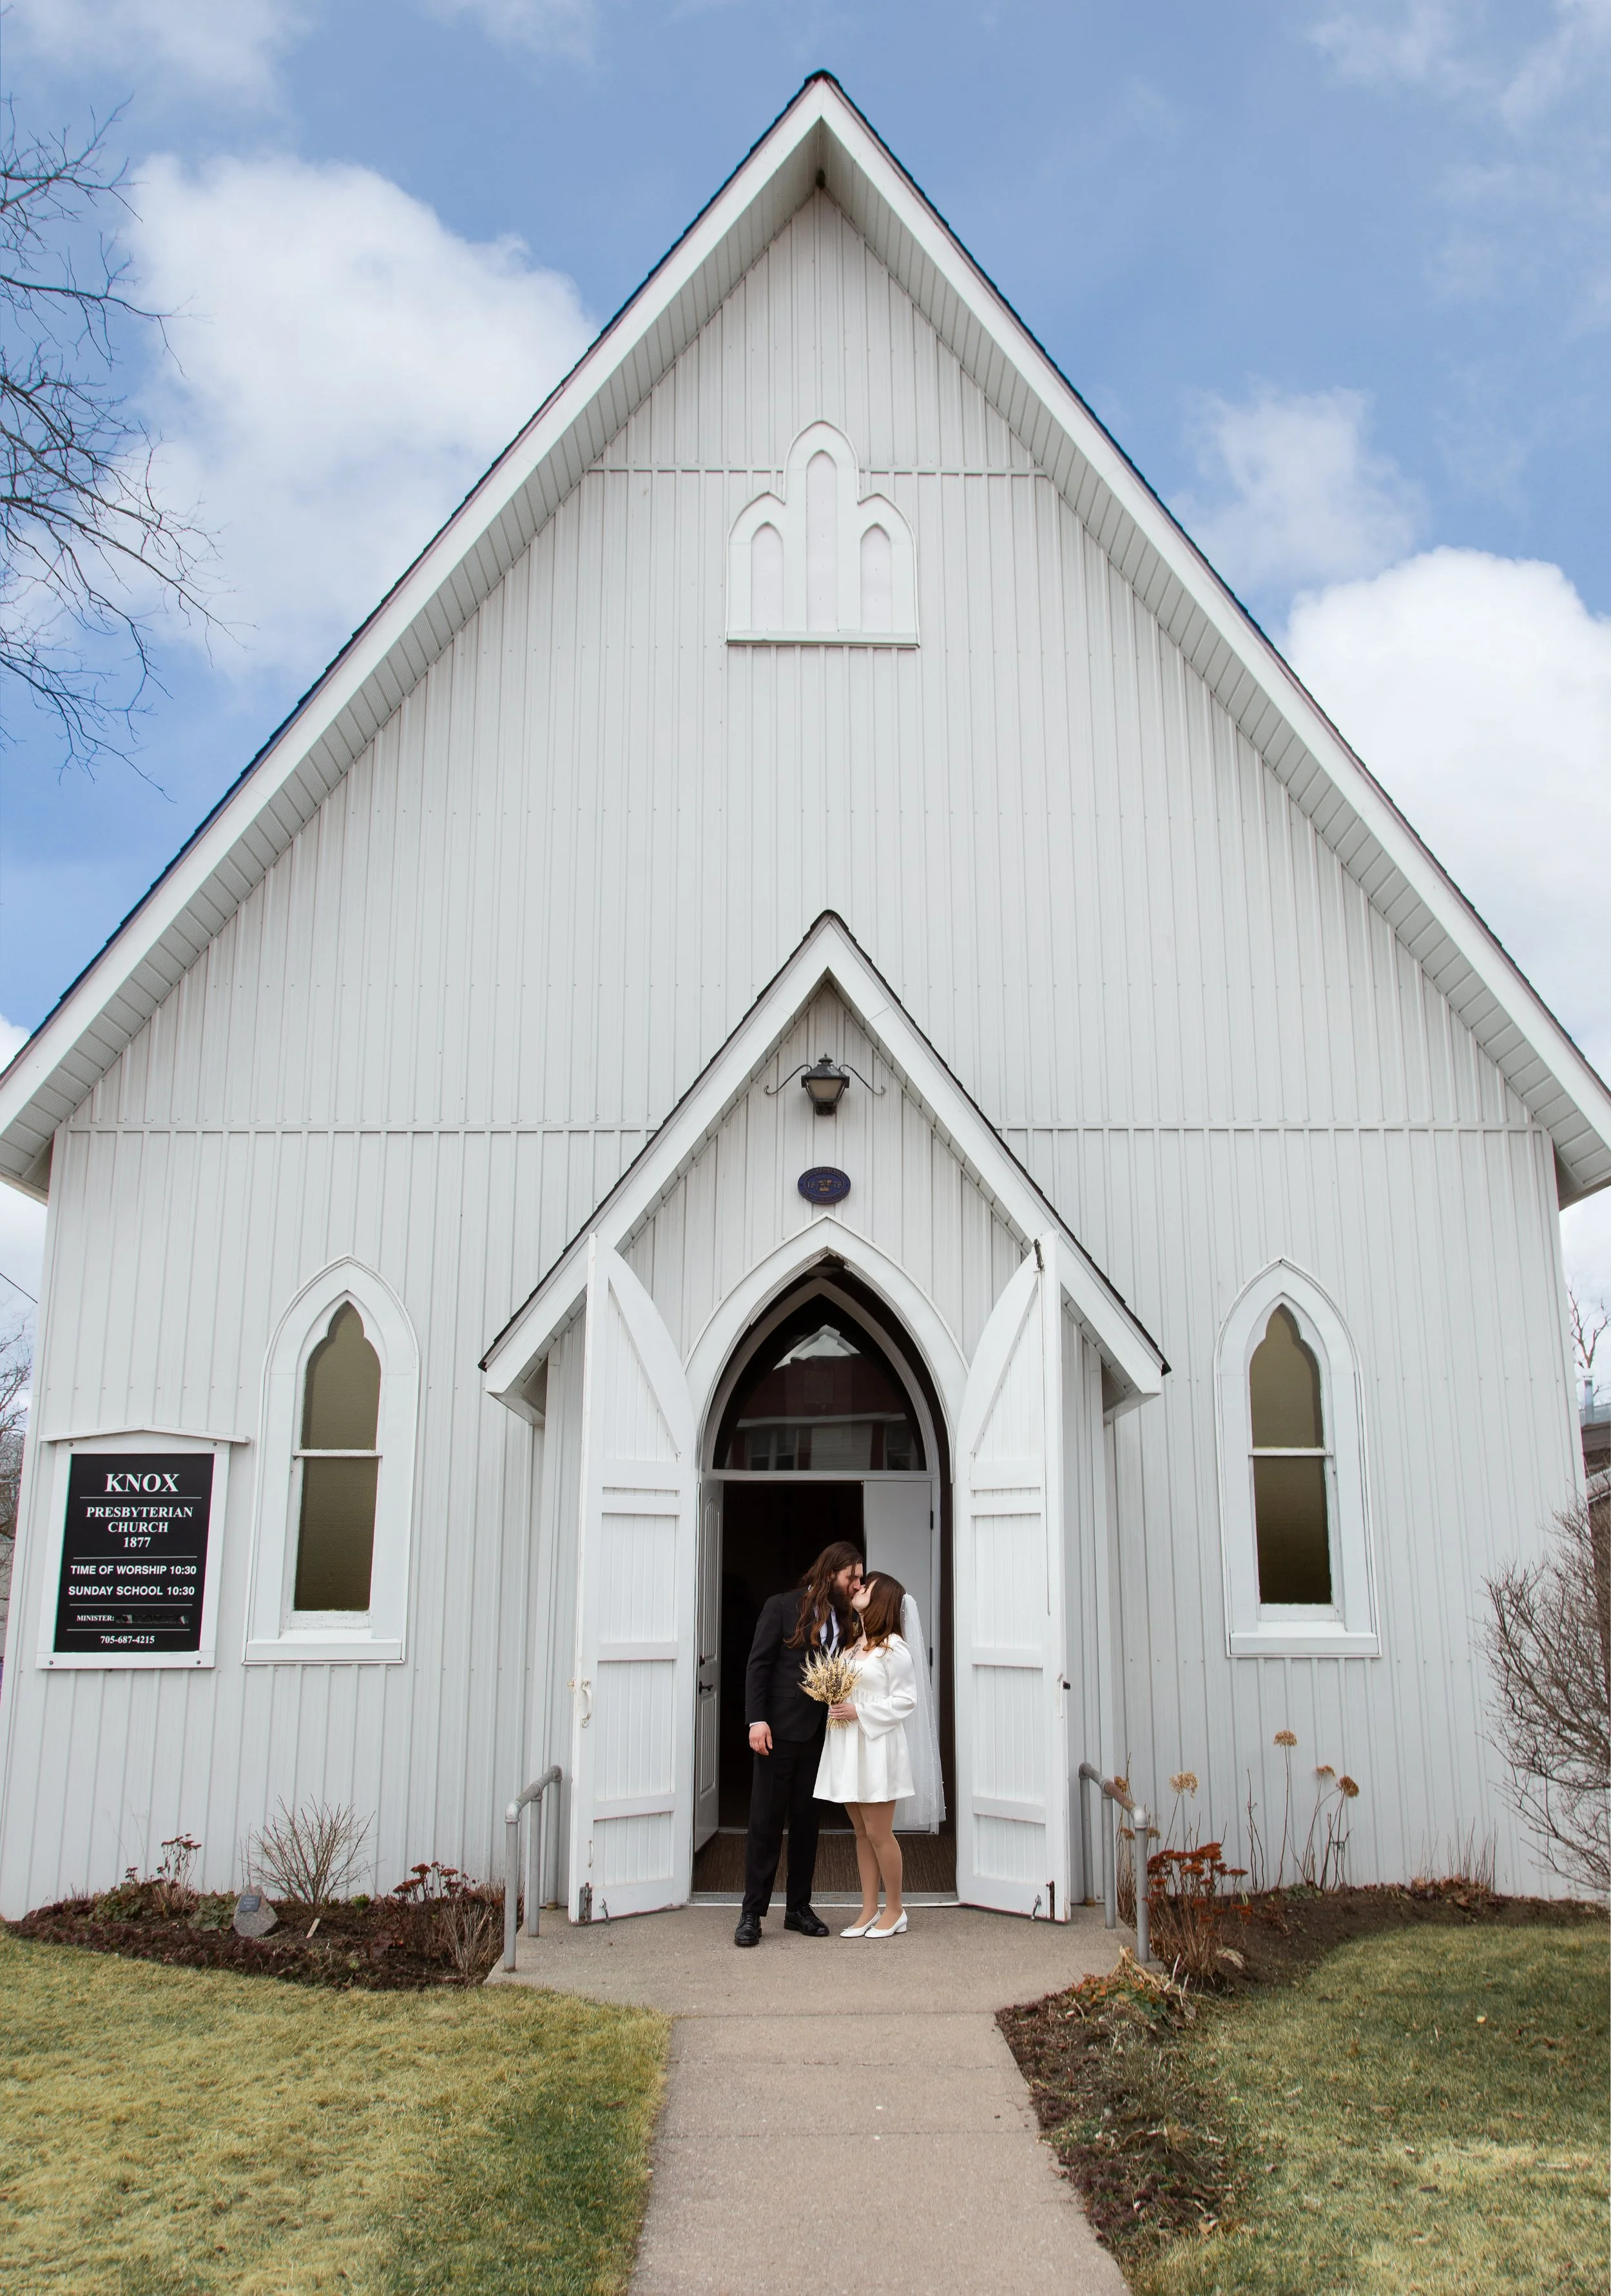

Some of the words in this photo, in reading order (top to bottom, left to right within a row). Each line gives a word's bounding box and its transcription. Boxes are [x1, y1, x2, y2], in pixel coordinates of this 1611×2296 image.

[104, 1474, 179, 1492] KNOX
[86, 1507, 193, 1517] PRESBYTERIAN
[108, 1522, 168, 1532] CHURCH
[124, 1537, 151, 1547] 1877
[71, 1566, 96, 1574] TIME
[100, 1566, 113, 1574] OF
[117, 1566, 166, 1574] WORSHIP
[170, 1566, 197, 1574] 10:30
[69, 1586, 113, 1595] SUNDAY
[117, 1586, 162, 1595] SCHOOL
